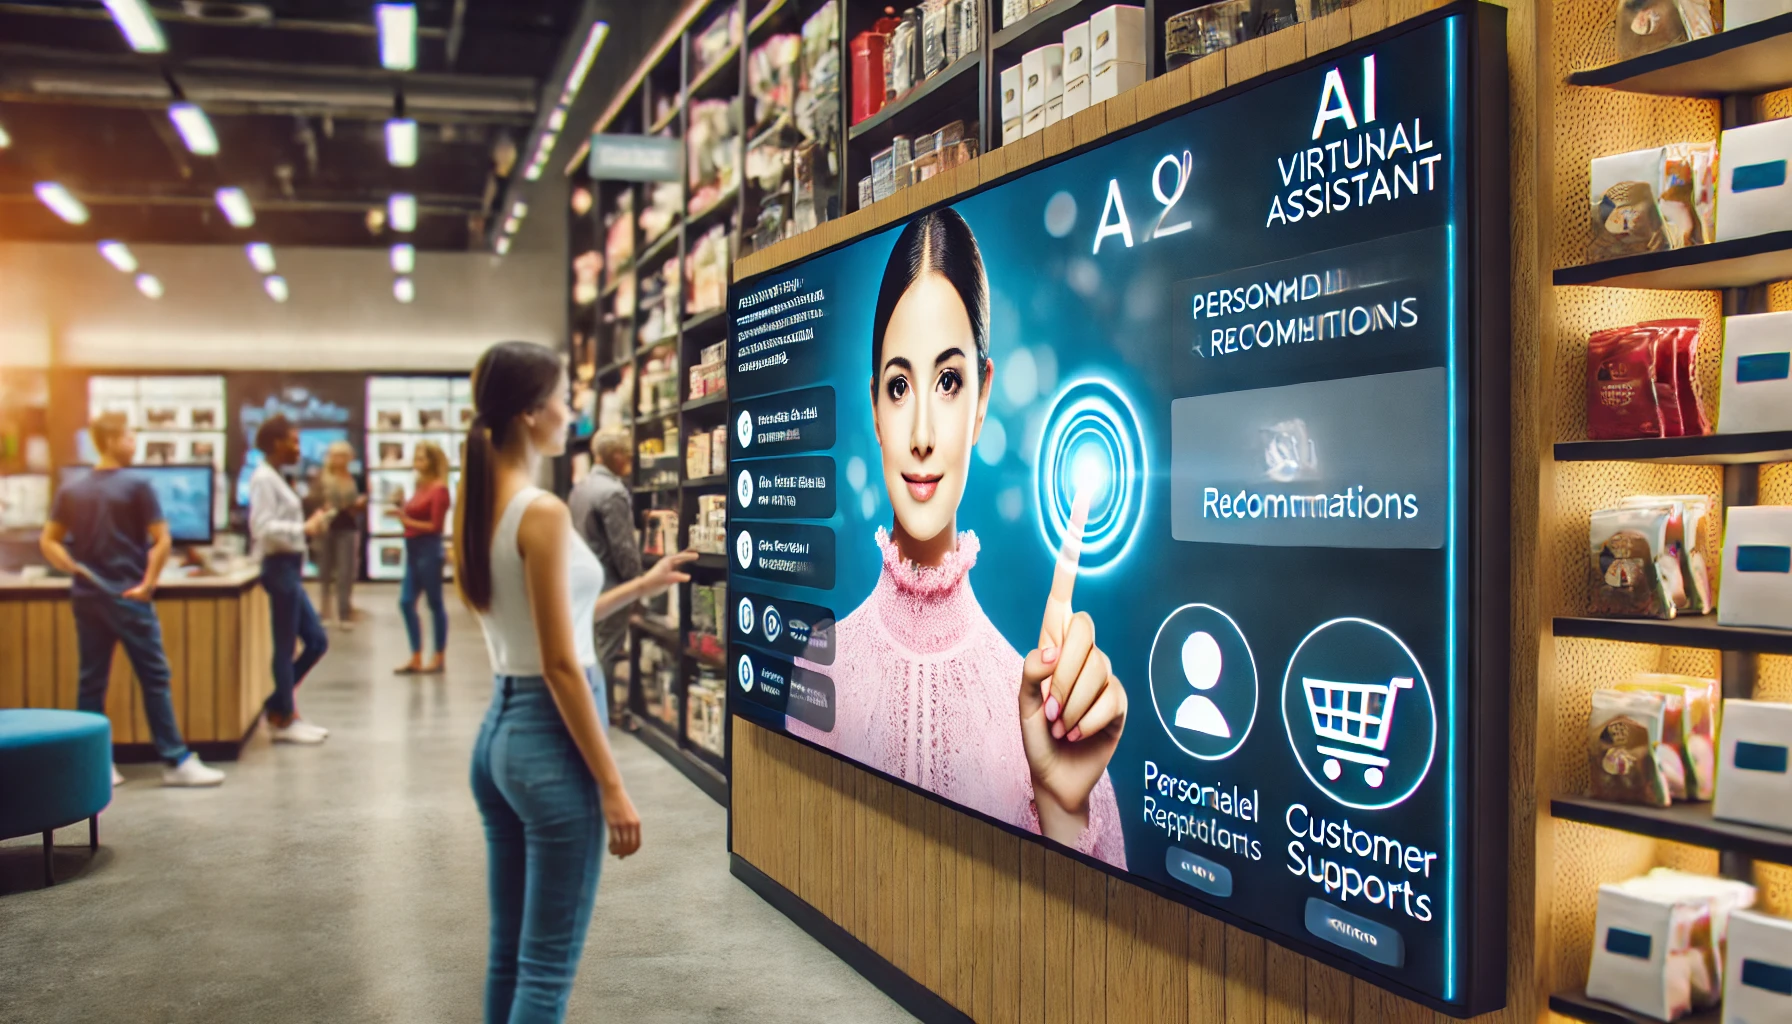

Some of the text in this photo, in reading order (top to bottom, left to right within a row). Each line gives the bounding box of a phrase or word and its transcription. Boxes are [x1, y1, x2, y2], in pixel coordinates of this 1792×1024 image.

[1312, 53, 1376, 140] AI
[1093, 178, 1133, 255] A
[1266, 153, 1442, 228] ASSISTANT
[1286, 803, 1438, 878] Customer
[1286, 840, 1433, 922] Supports
